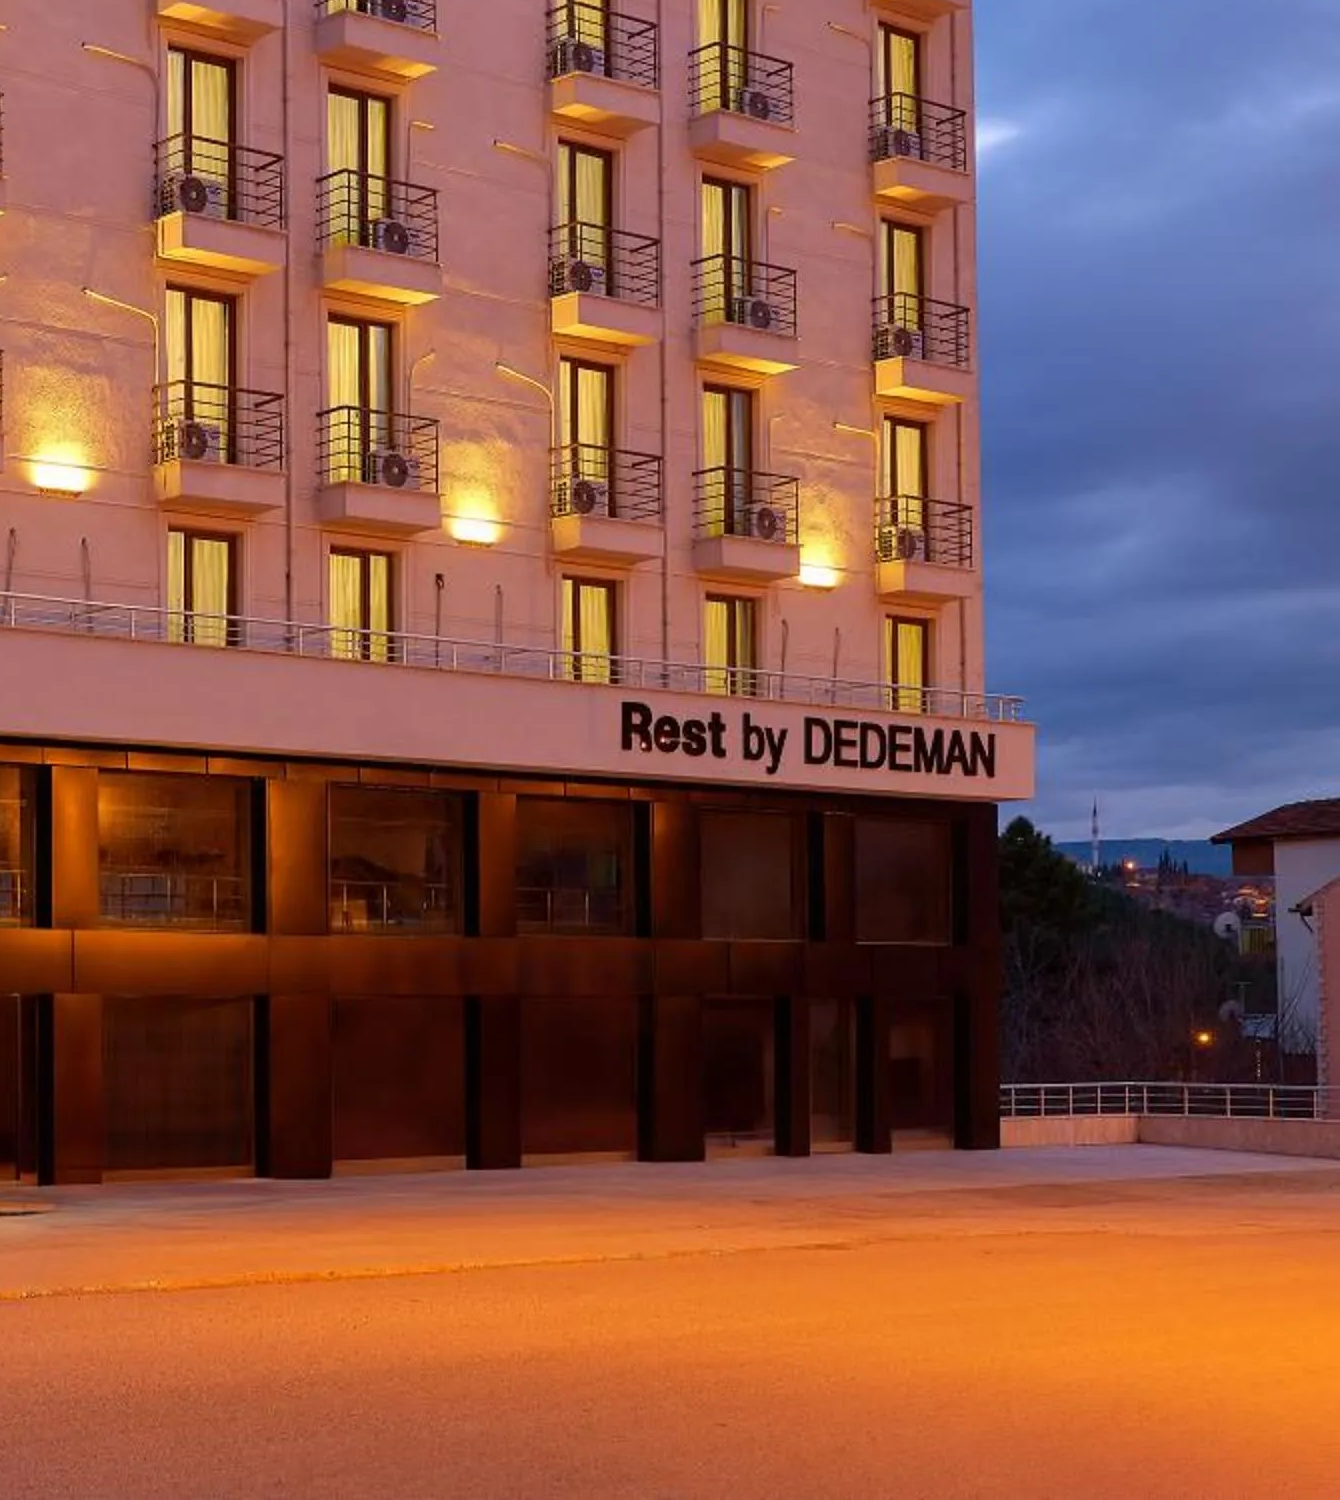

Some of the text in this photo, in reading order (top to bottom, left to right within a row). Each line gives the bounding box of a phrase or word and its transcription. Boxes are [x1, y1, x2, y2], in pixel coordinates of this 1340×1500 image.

[620, 701, 996, 778] Rest by DEDEMAN
